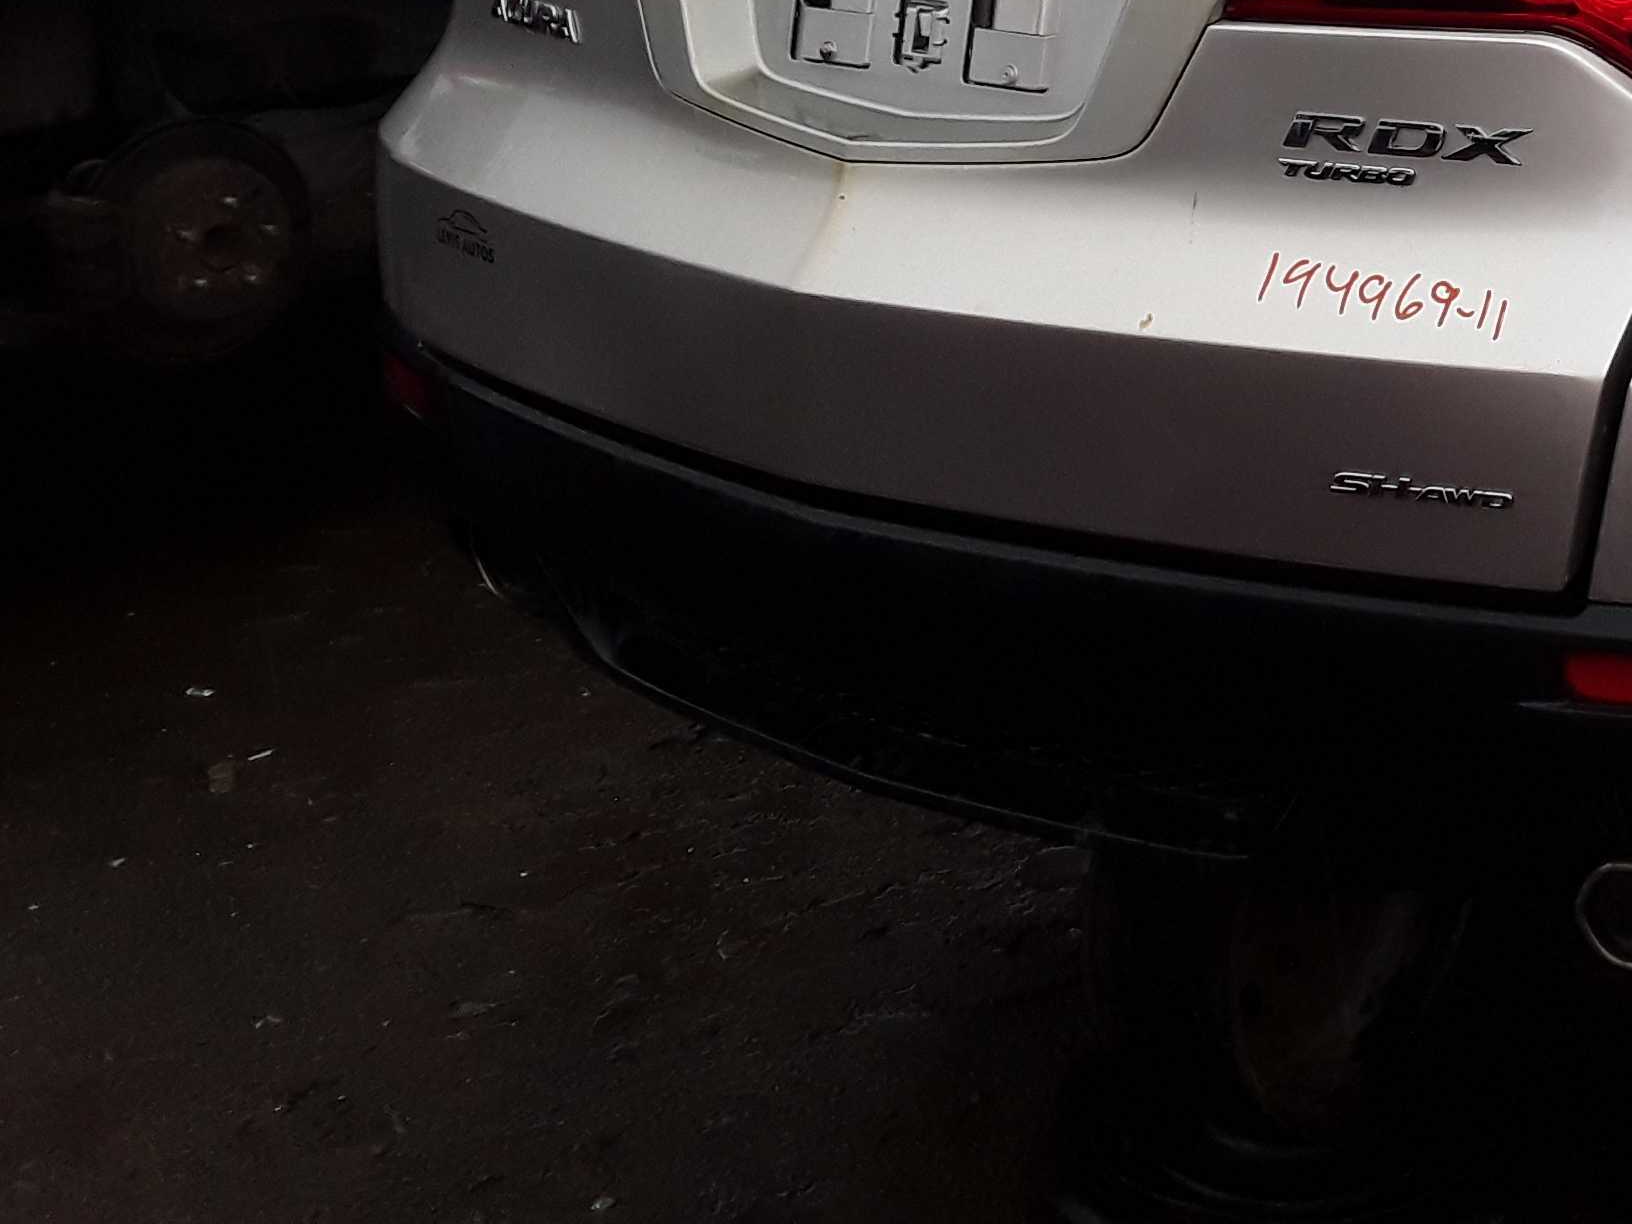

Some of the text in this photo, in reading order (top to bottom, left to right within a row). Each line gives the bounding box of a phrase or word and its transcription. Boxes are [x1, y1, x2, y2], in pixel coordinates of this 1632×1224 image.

[1282, 110, 1534, 166] RDX
[1278, 157, 1418, 186] TURBO
[1257, 251, 1509, 341] 194969-11
